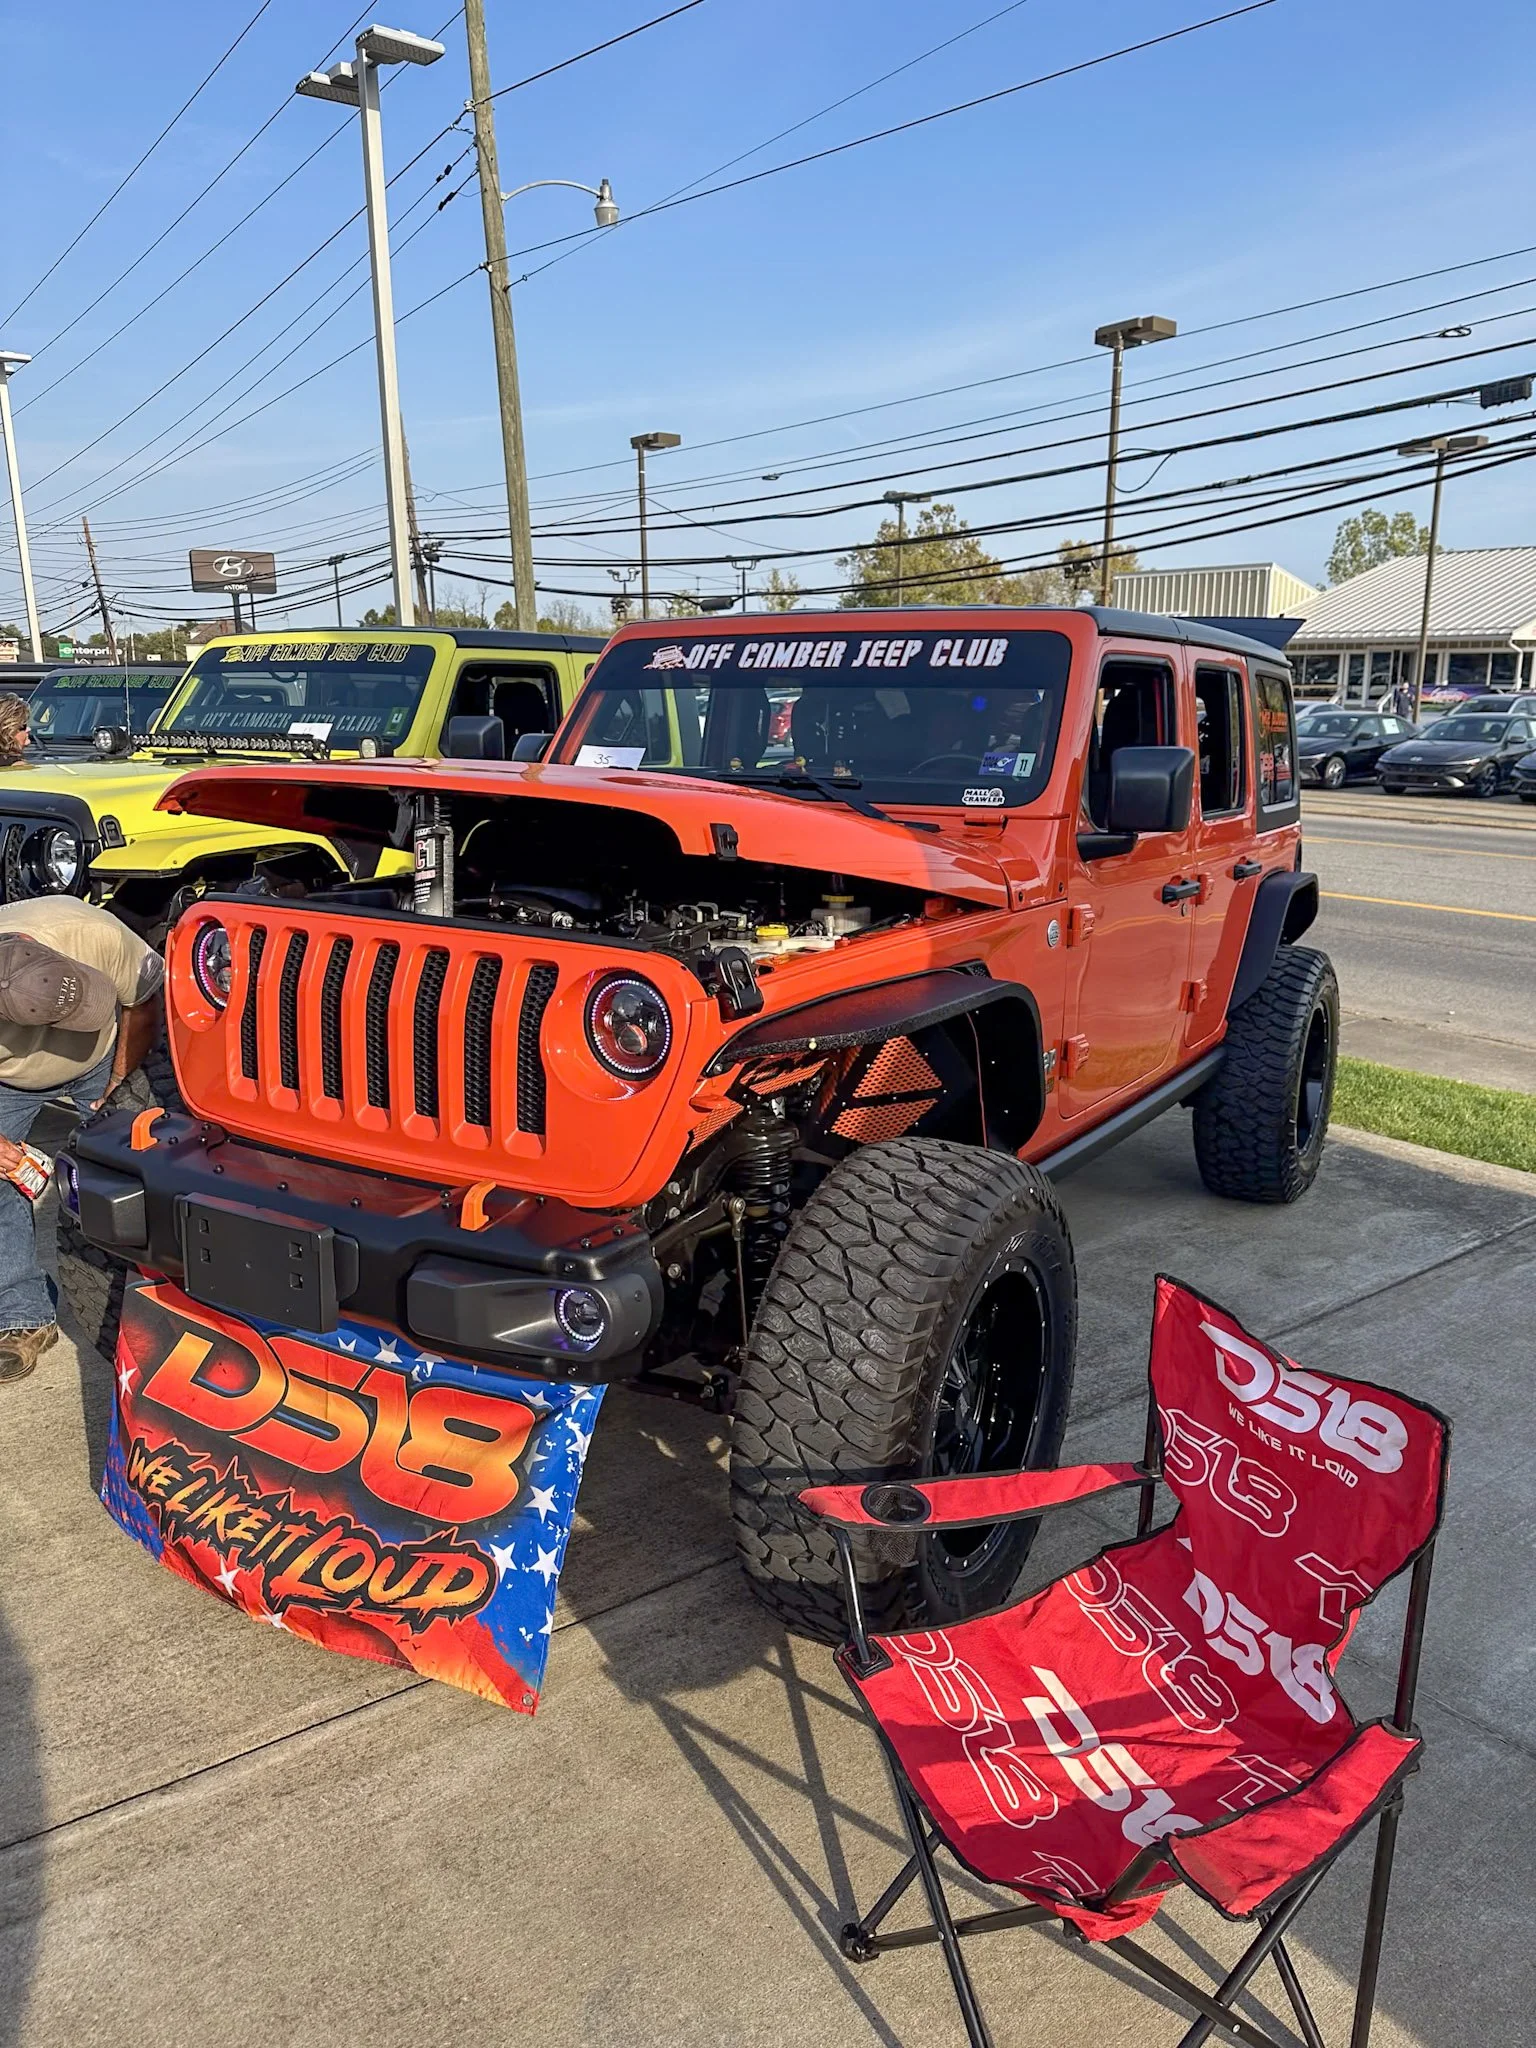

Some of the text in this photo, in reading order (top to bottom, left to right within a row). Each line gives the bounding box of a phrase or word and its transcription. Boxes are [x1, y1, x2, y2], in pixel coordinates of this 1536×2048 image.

[60, 646, 123, 656] enterprie
[241, 644, 272, 662] OFF
[327, 643, 368, 661] JEEP
[366, 643, 411, 662] CLUB
[684, 638, 1009, 669] OFF CAMBER JEEP CLUB
[593, 753, 614, 765] 35
[136, 1286, 537, 1523] DS18
[1199, 1321, 1409, 1473] DS18
[1156, 1404, 1298, 1538] S18
[1228, 1402, 1359, 1489] WE LIKE IT LOUD
[129, 1446, 490, 1615] WE LIKE IT LOUD
